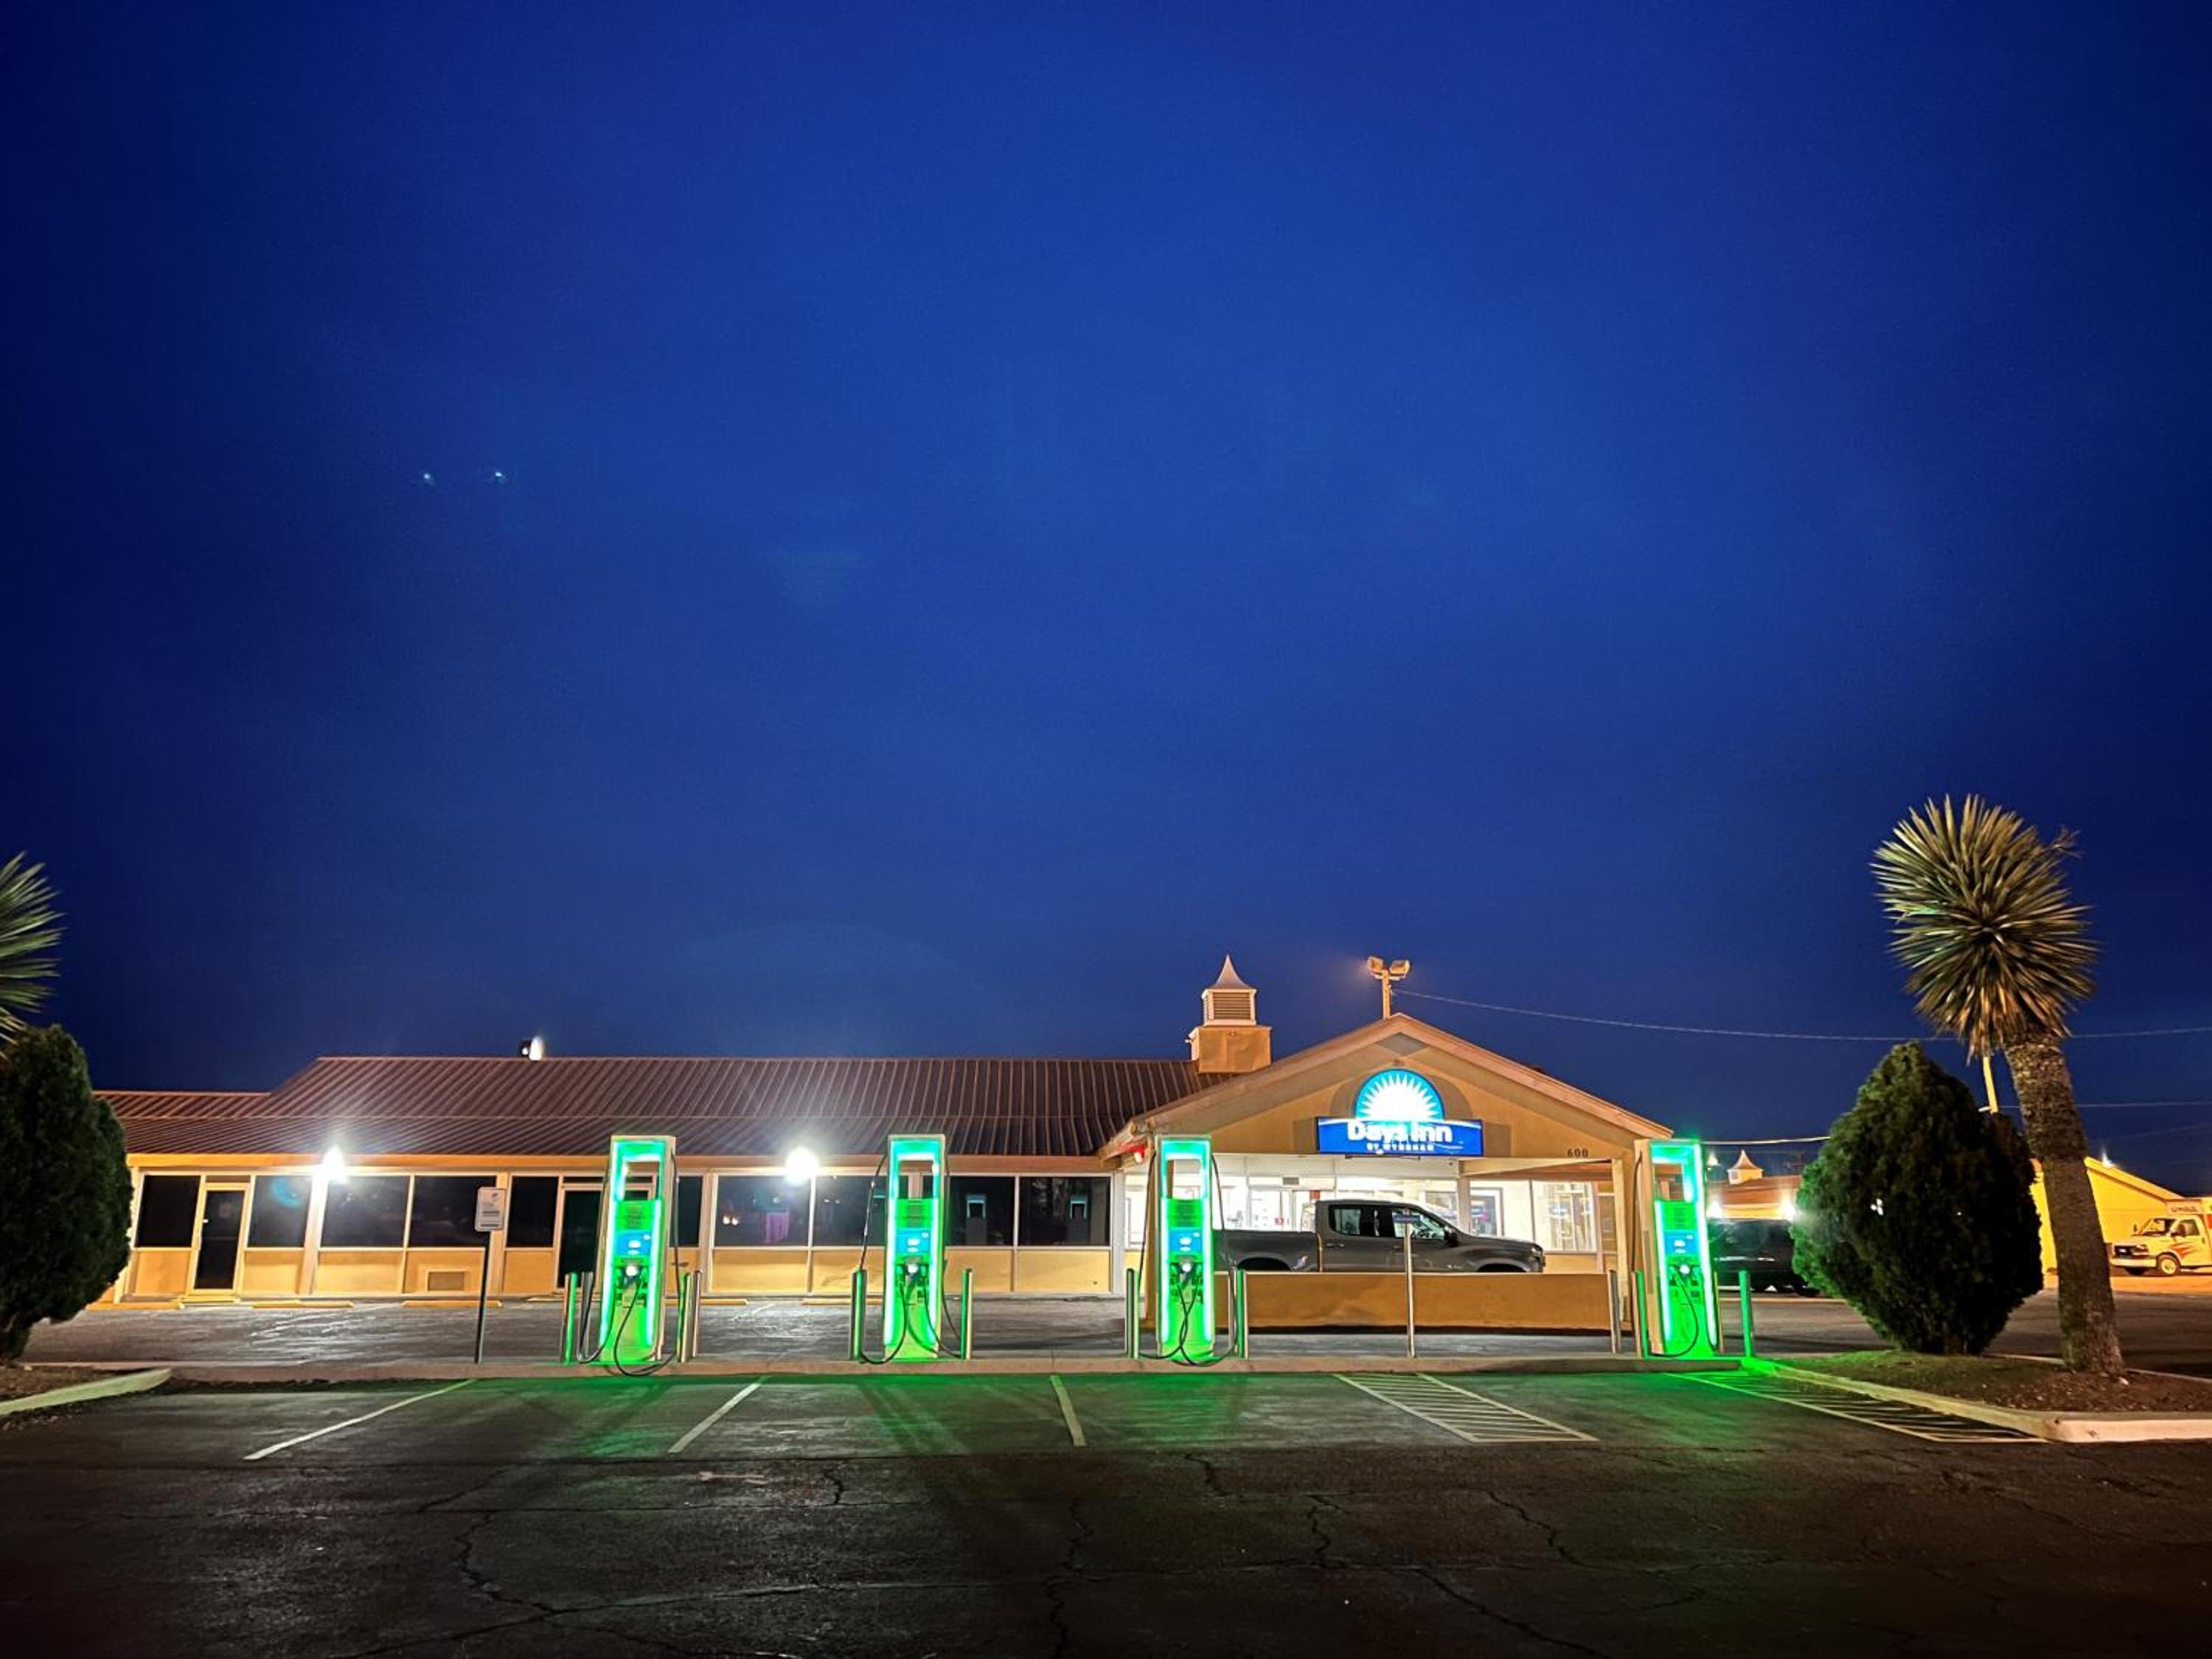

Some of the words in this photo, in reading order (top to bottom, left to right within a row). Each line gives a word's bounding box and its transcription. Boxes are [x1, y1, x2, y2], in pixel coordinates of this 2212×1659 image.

[1347, 1121, 1408, 1144] Days
[1411, 1121, 1453, 1142] Inn
[1567, 1148, 1588, 1158] 600
